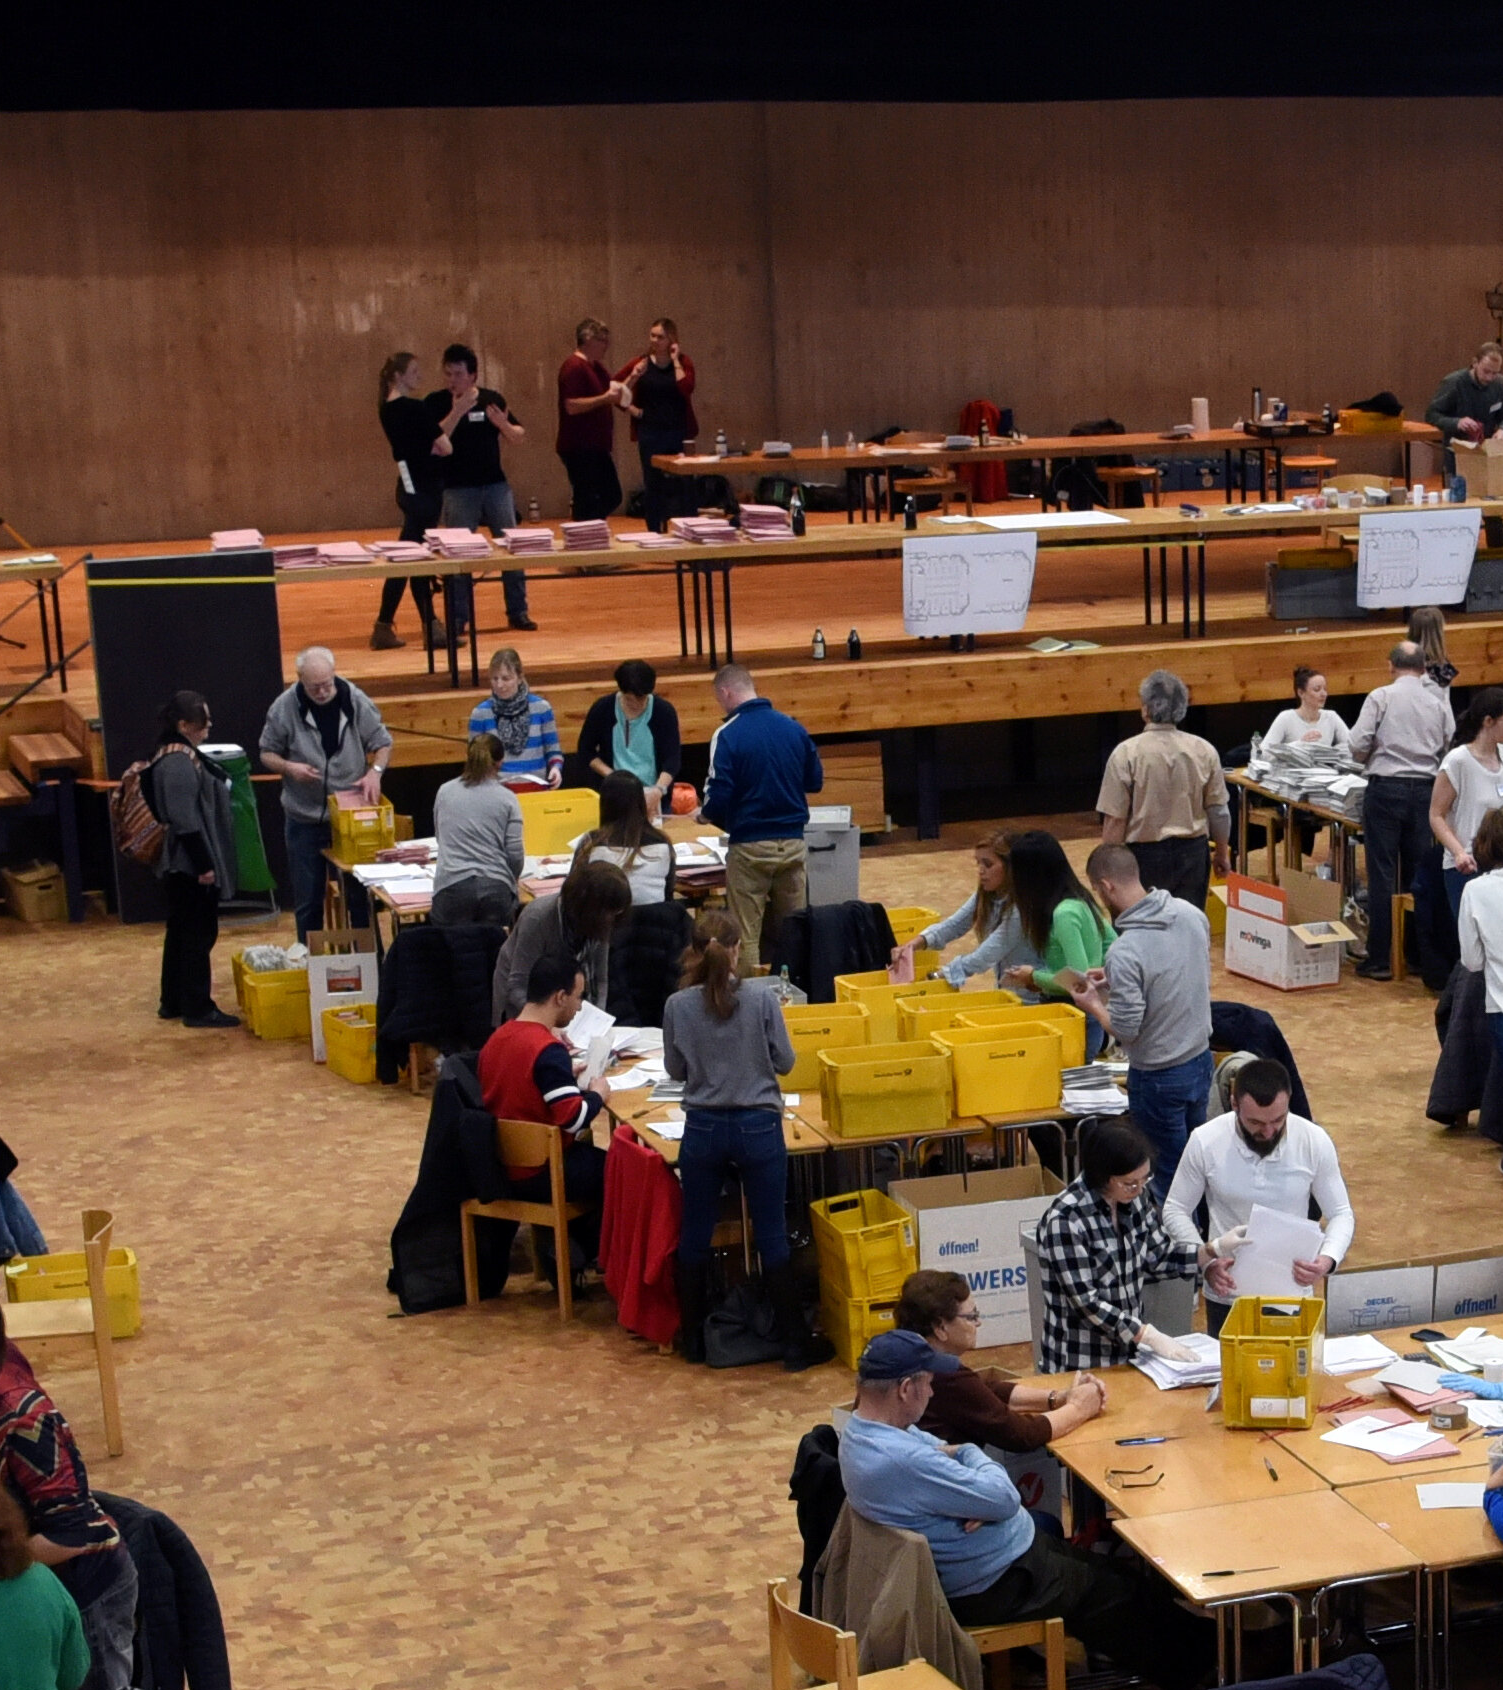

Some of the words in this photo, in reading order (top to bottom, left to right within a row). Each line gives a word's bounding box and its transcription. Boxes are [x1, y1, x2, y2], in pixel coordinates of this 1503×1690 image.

[1240, 929, 1272, 950] movinga
[939, 1238, 979, 1257] öffnen!
[965, 1266, 1028, 1291] WERS
[1454, 1293, 1497, 1316] öffnen!
